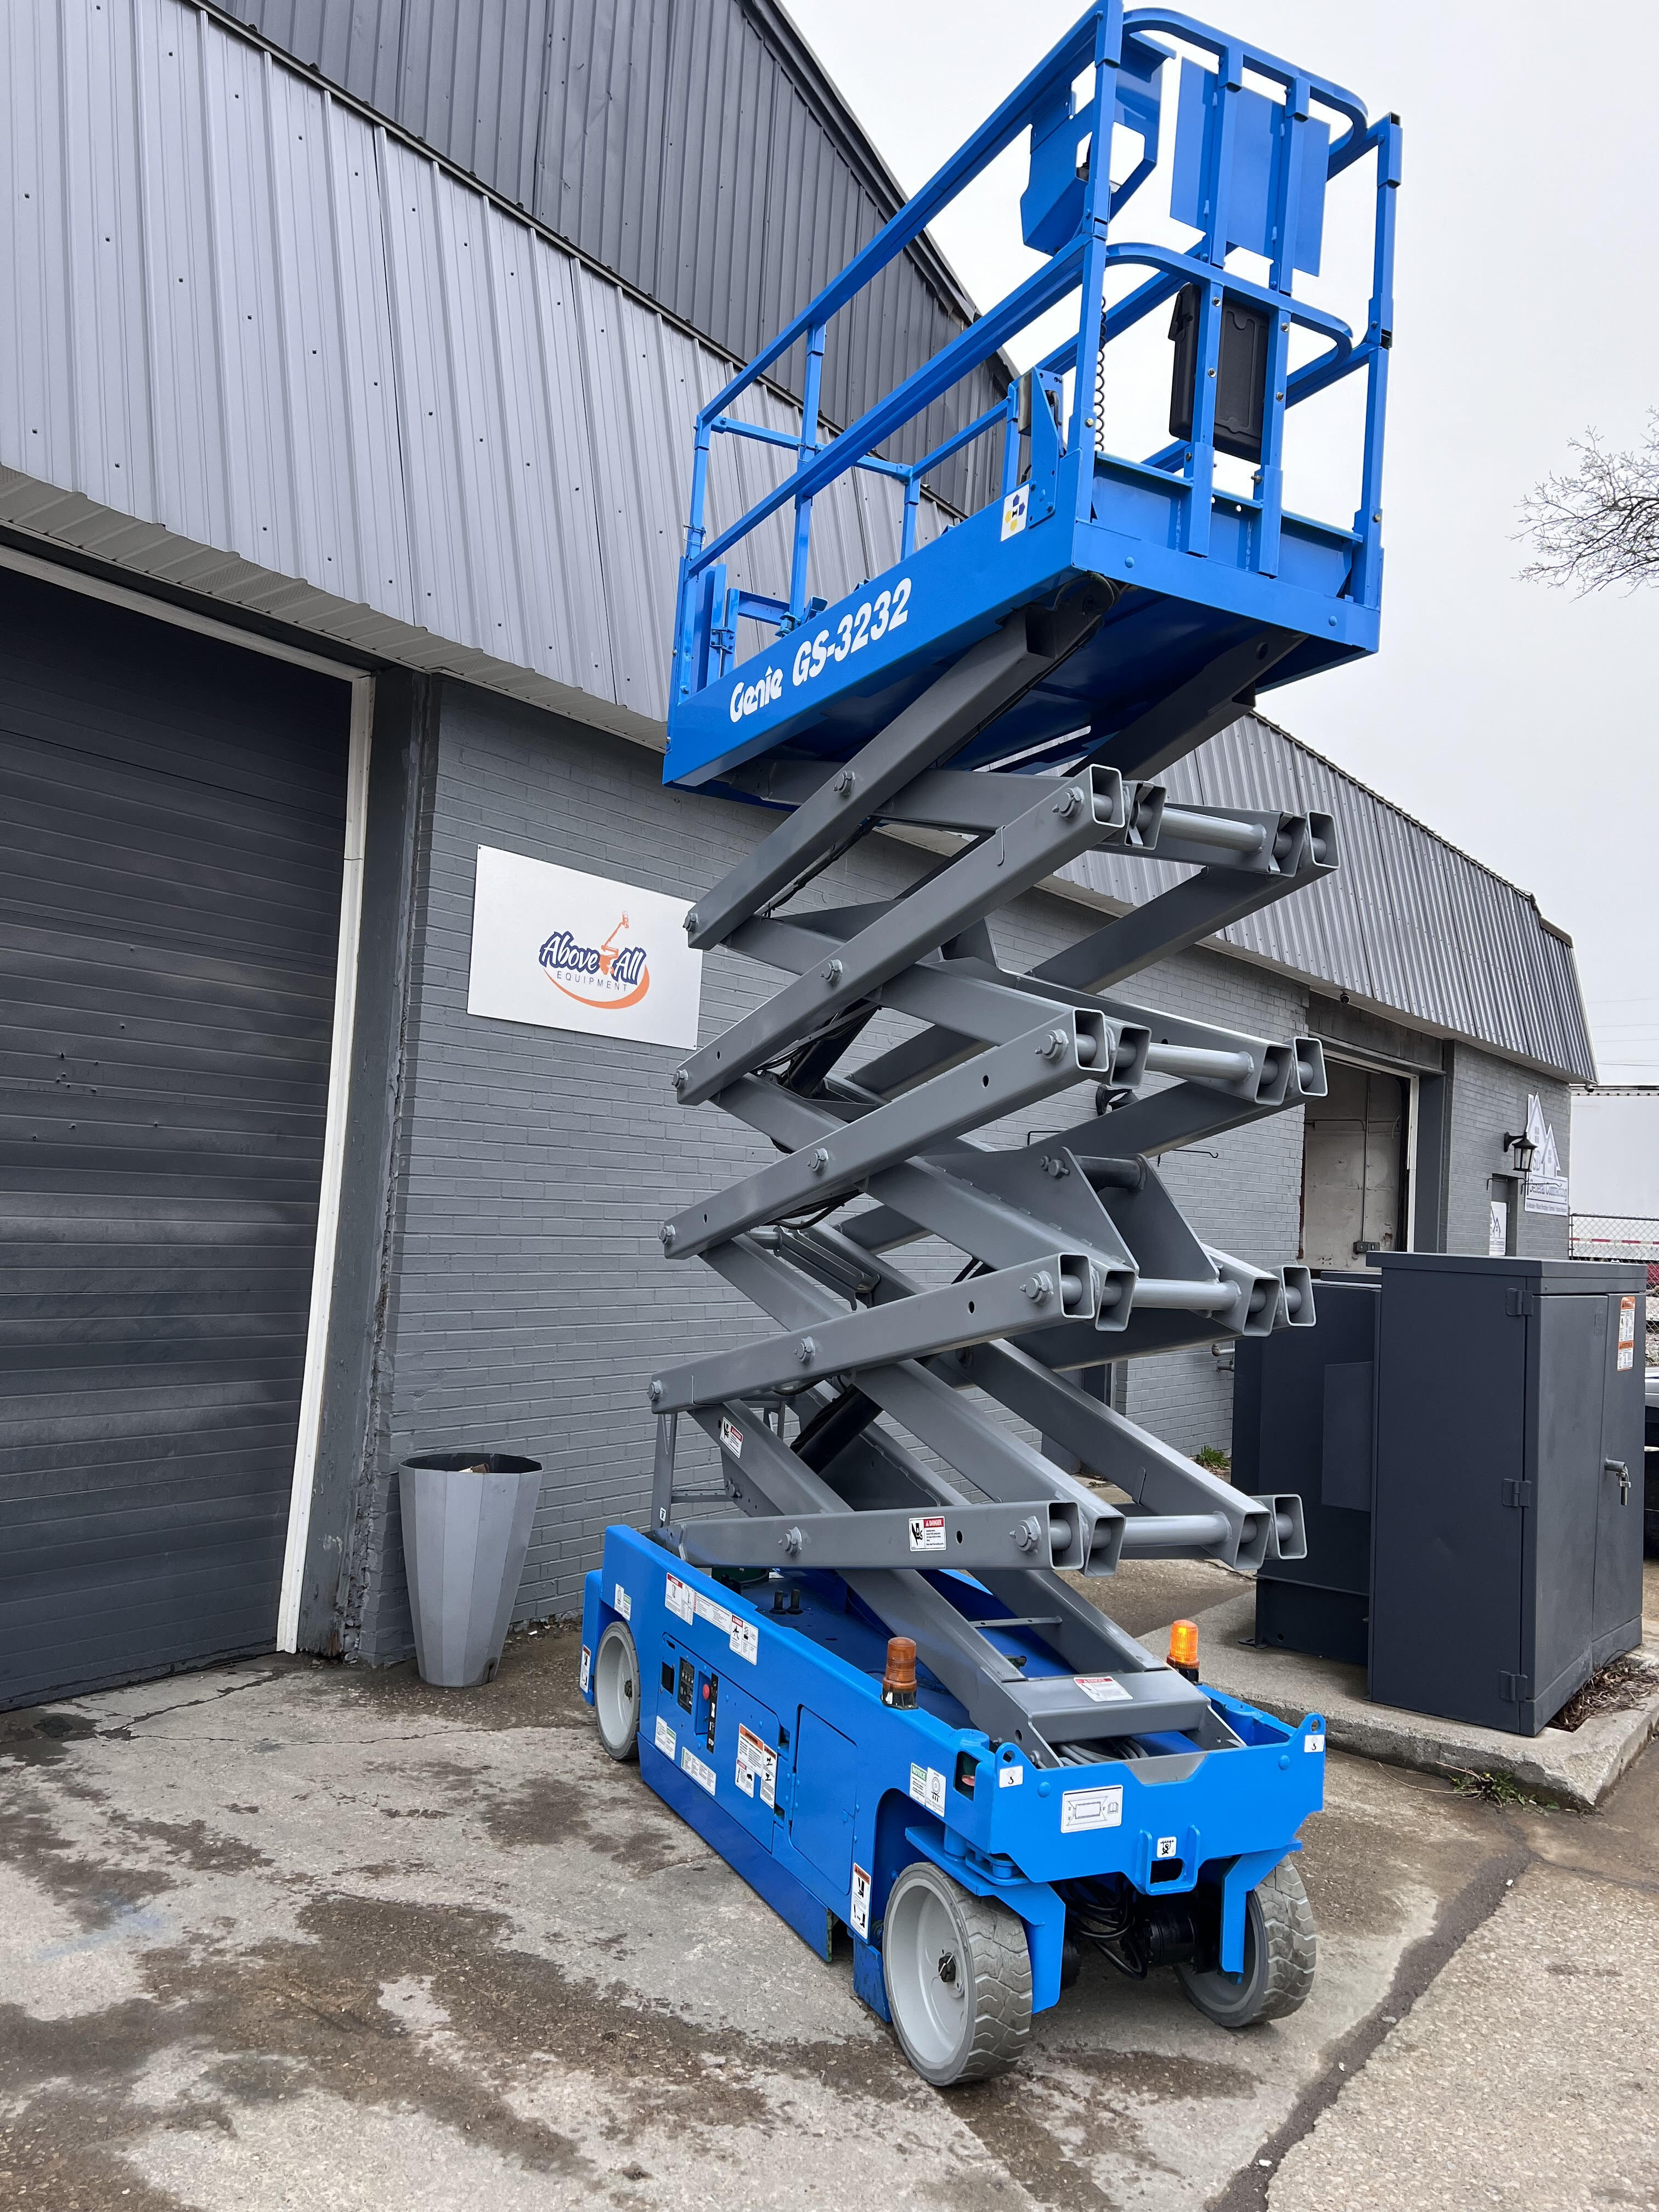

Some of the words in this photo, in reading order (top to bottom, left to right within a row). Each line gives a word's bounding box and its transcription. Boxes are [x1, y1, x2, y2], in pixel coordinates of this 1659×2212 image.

[730, 665, 783, 723] Genie
[793, 578, 912, 686] GS-3232
[539, 931, 600, 974] Above
[611, 947, 647, 985] All
[557, 971, 628, 991] EQUIPMENT
[929, 1519, 942, 1527] DANGER
[912, 1765, 927, 1781] NOTICE
